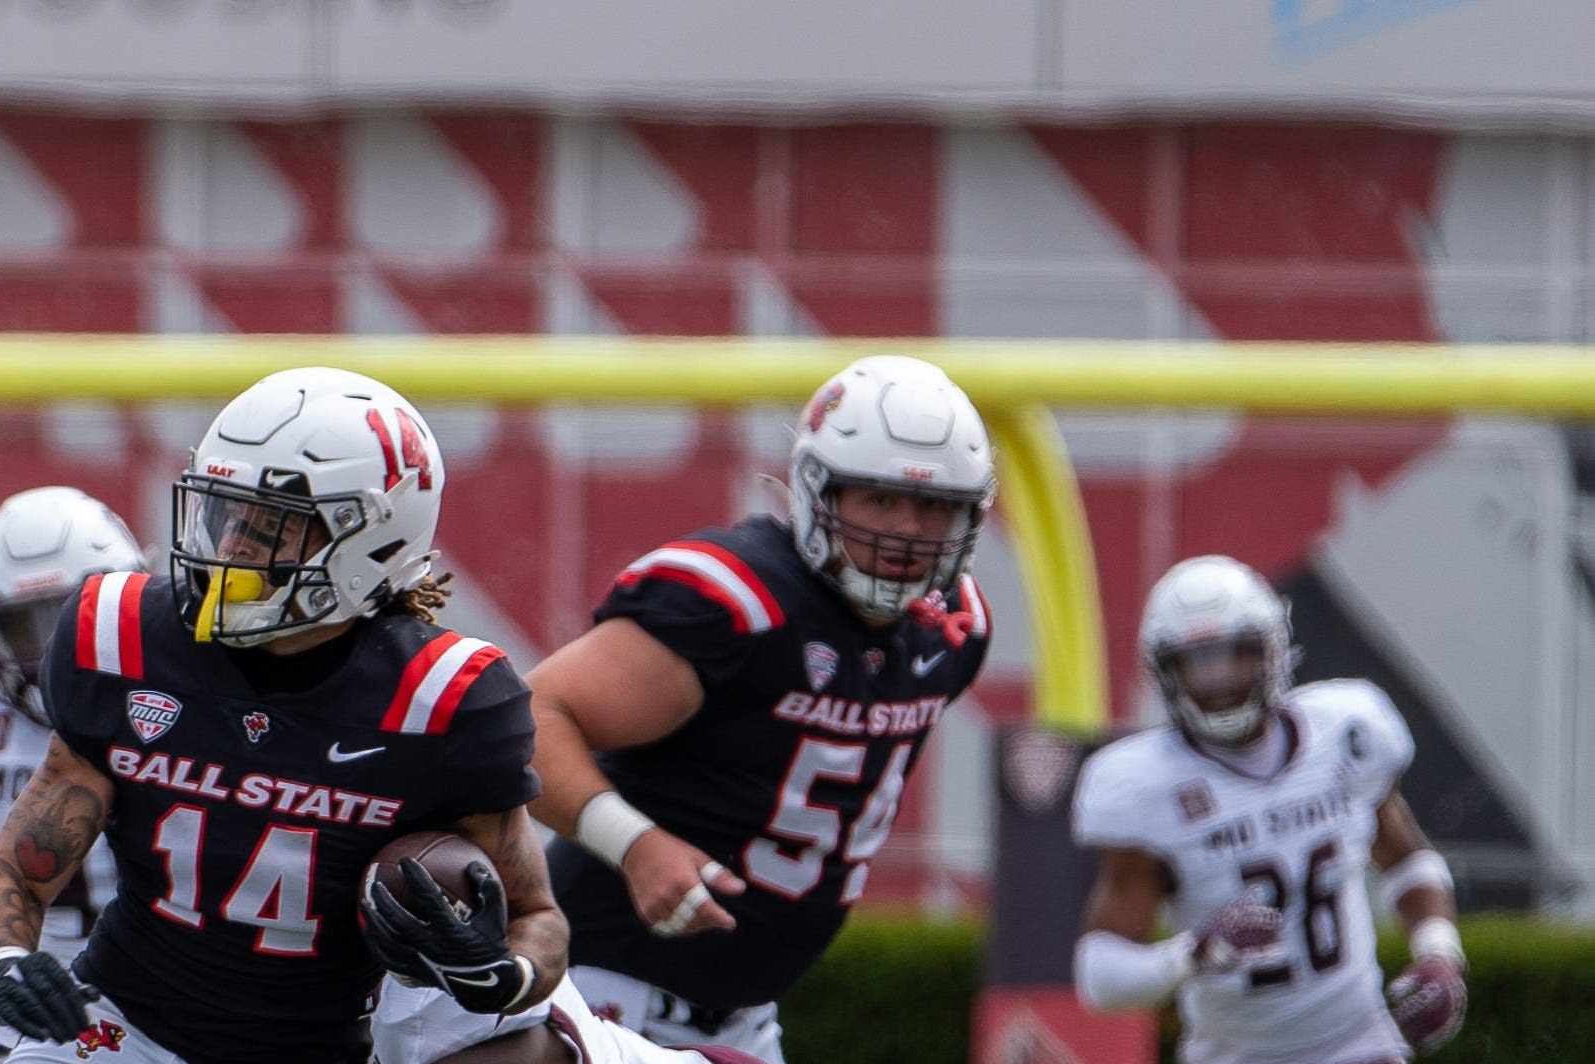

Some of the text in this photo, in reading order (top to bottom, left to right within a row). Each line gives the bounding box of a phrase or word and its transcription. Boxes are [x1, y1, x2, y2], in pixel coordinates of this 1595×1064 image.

[365, 408, 433, 492] 14
[129, 704, 175, 725] MAC
[773, 690, 868, 736] BALL
[108, 746, 403, 828] BALL STATE
[742, 734, 916, 906] 54
[151, 802, 323, 957] 14
[1239, 838, 1341, 987] 26
